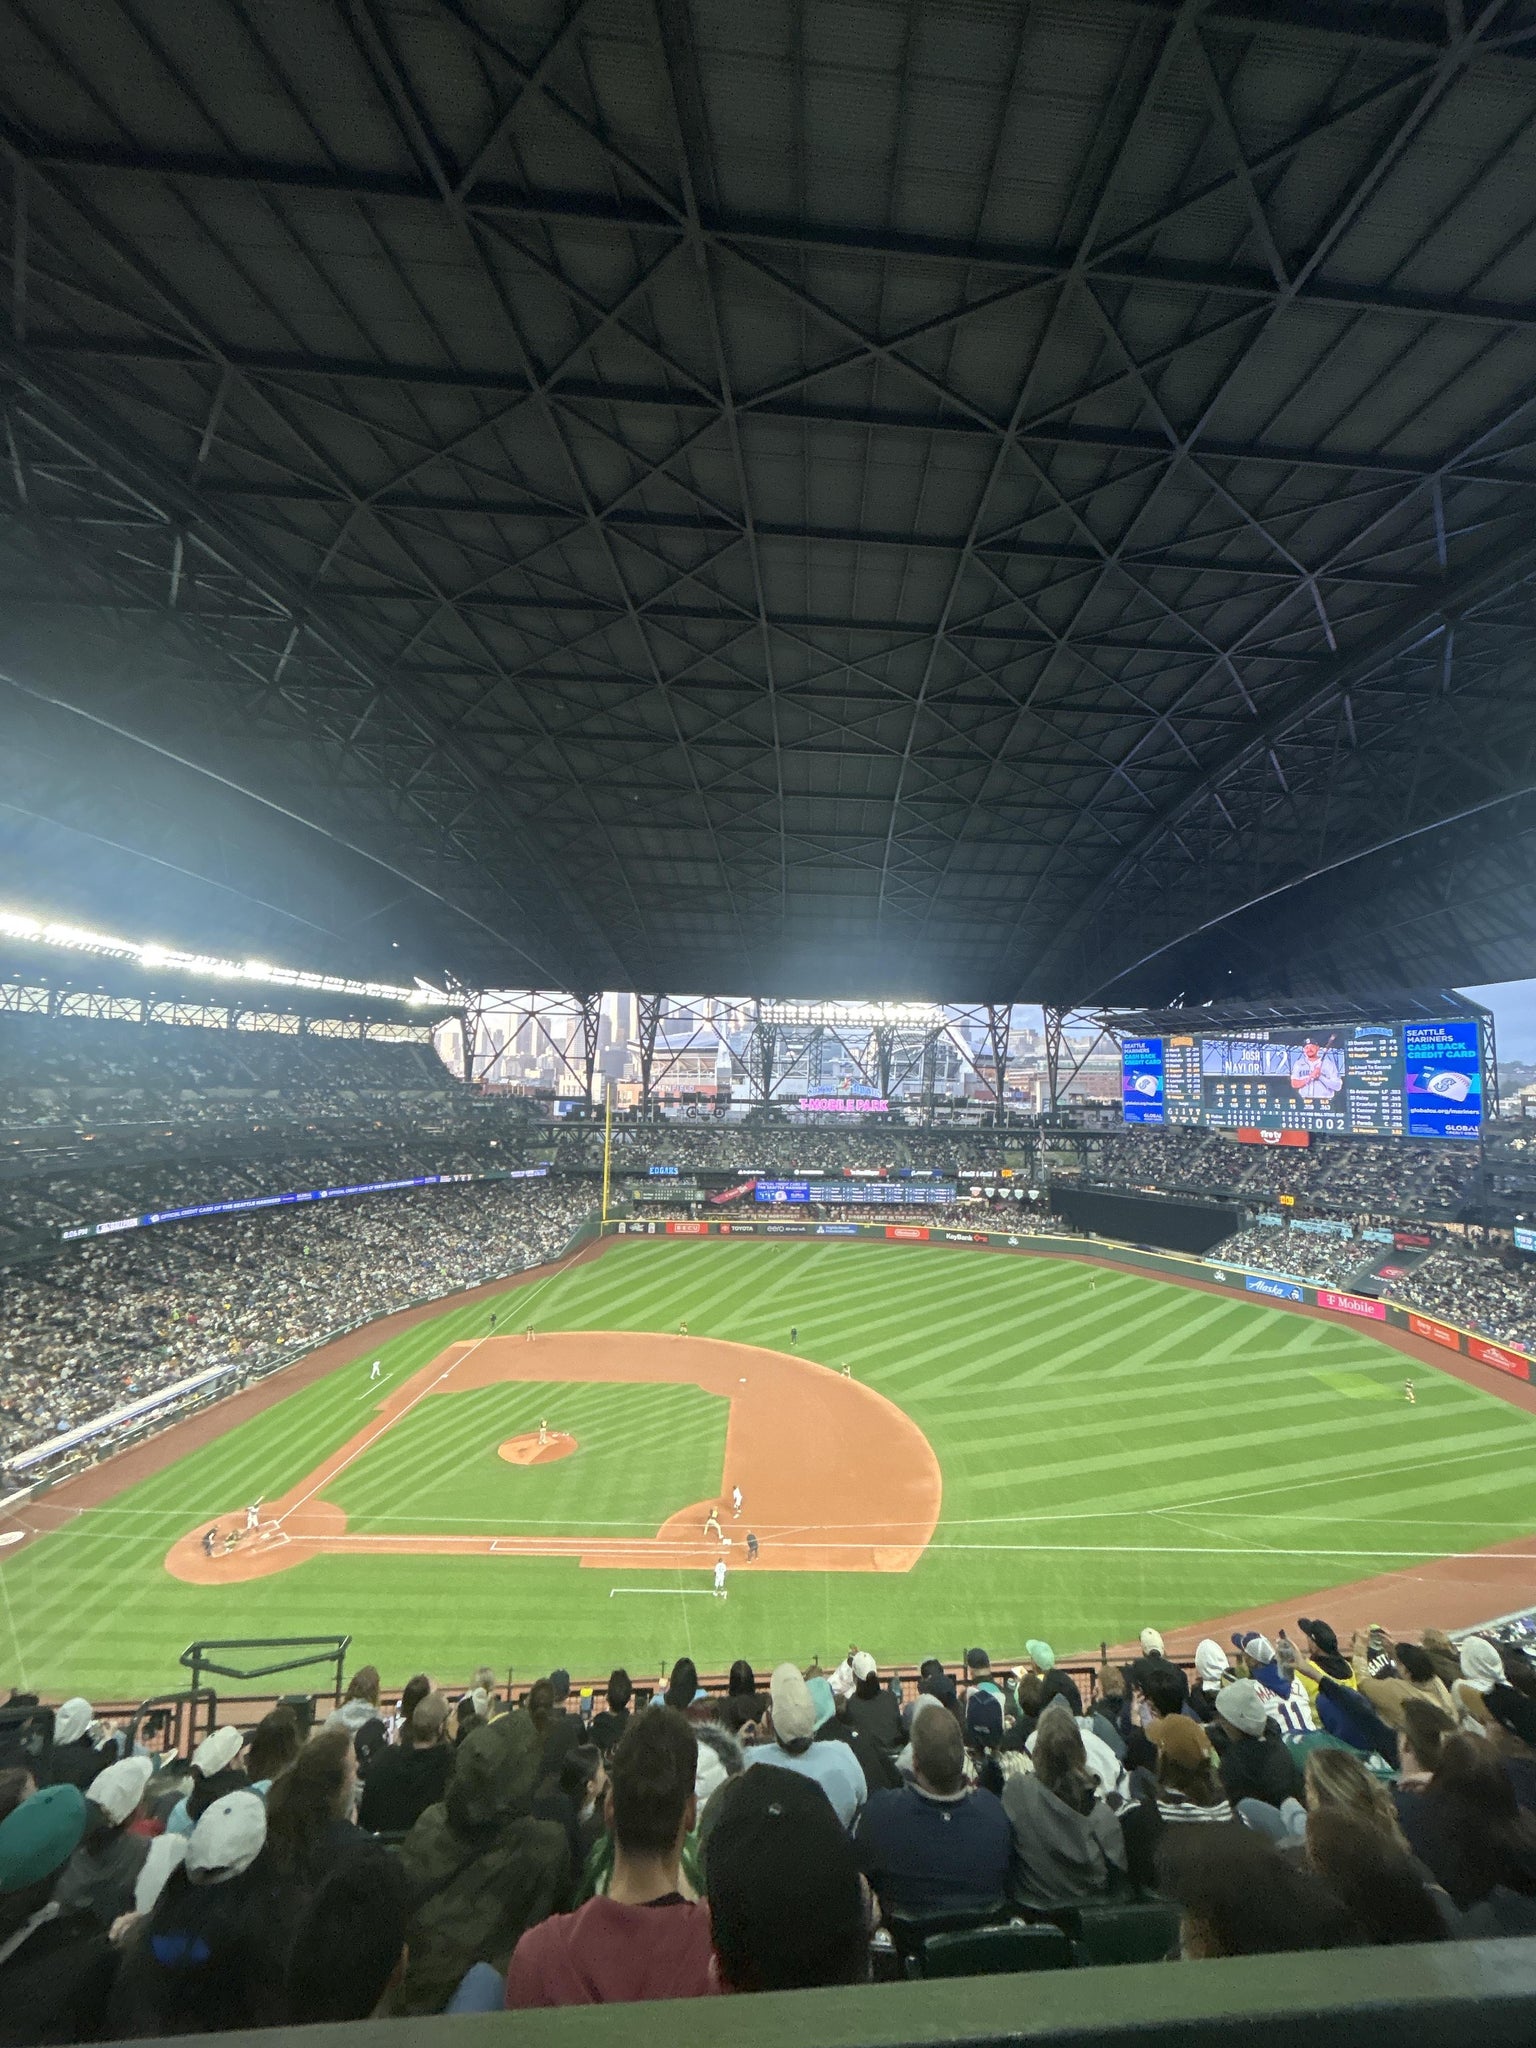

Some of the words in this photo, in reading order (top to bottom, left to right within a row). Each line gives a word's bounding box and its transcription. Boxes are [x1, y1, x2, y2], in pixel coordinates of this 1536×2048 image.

[1241, 1050, 1260, 1061] JOSH
[1225, 1061, 1260, 1073] NAYLOR
[799, 1098, 854, 1112] T-MOBILE
[856, 1099, 889, 1112] PARK
[1316, 1118, 1323, 1129] 0
[1326, 1119, 1334, 1129] 0
[1337, 1119, 1344, 1130] 2
[181, 1208, 198, 1216] CREDIT
[234, 1201, 255, 1209] SEATTLE
[946, 1233, 972, 1242] KeyBank
[1249, 1280, 1283, 1295] Alaska
[1338, 1297, 1374, 1313] Mobile
[1278, 1702, 1307, 1730] 11
